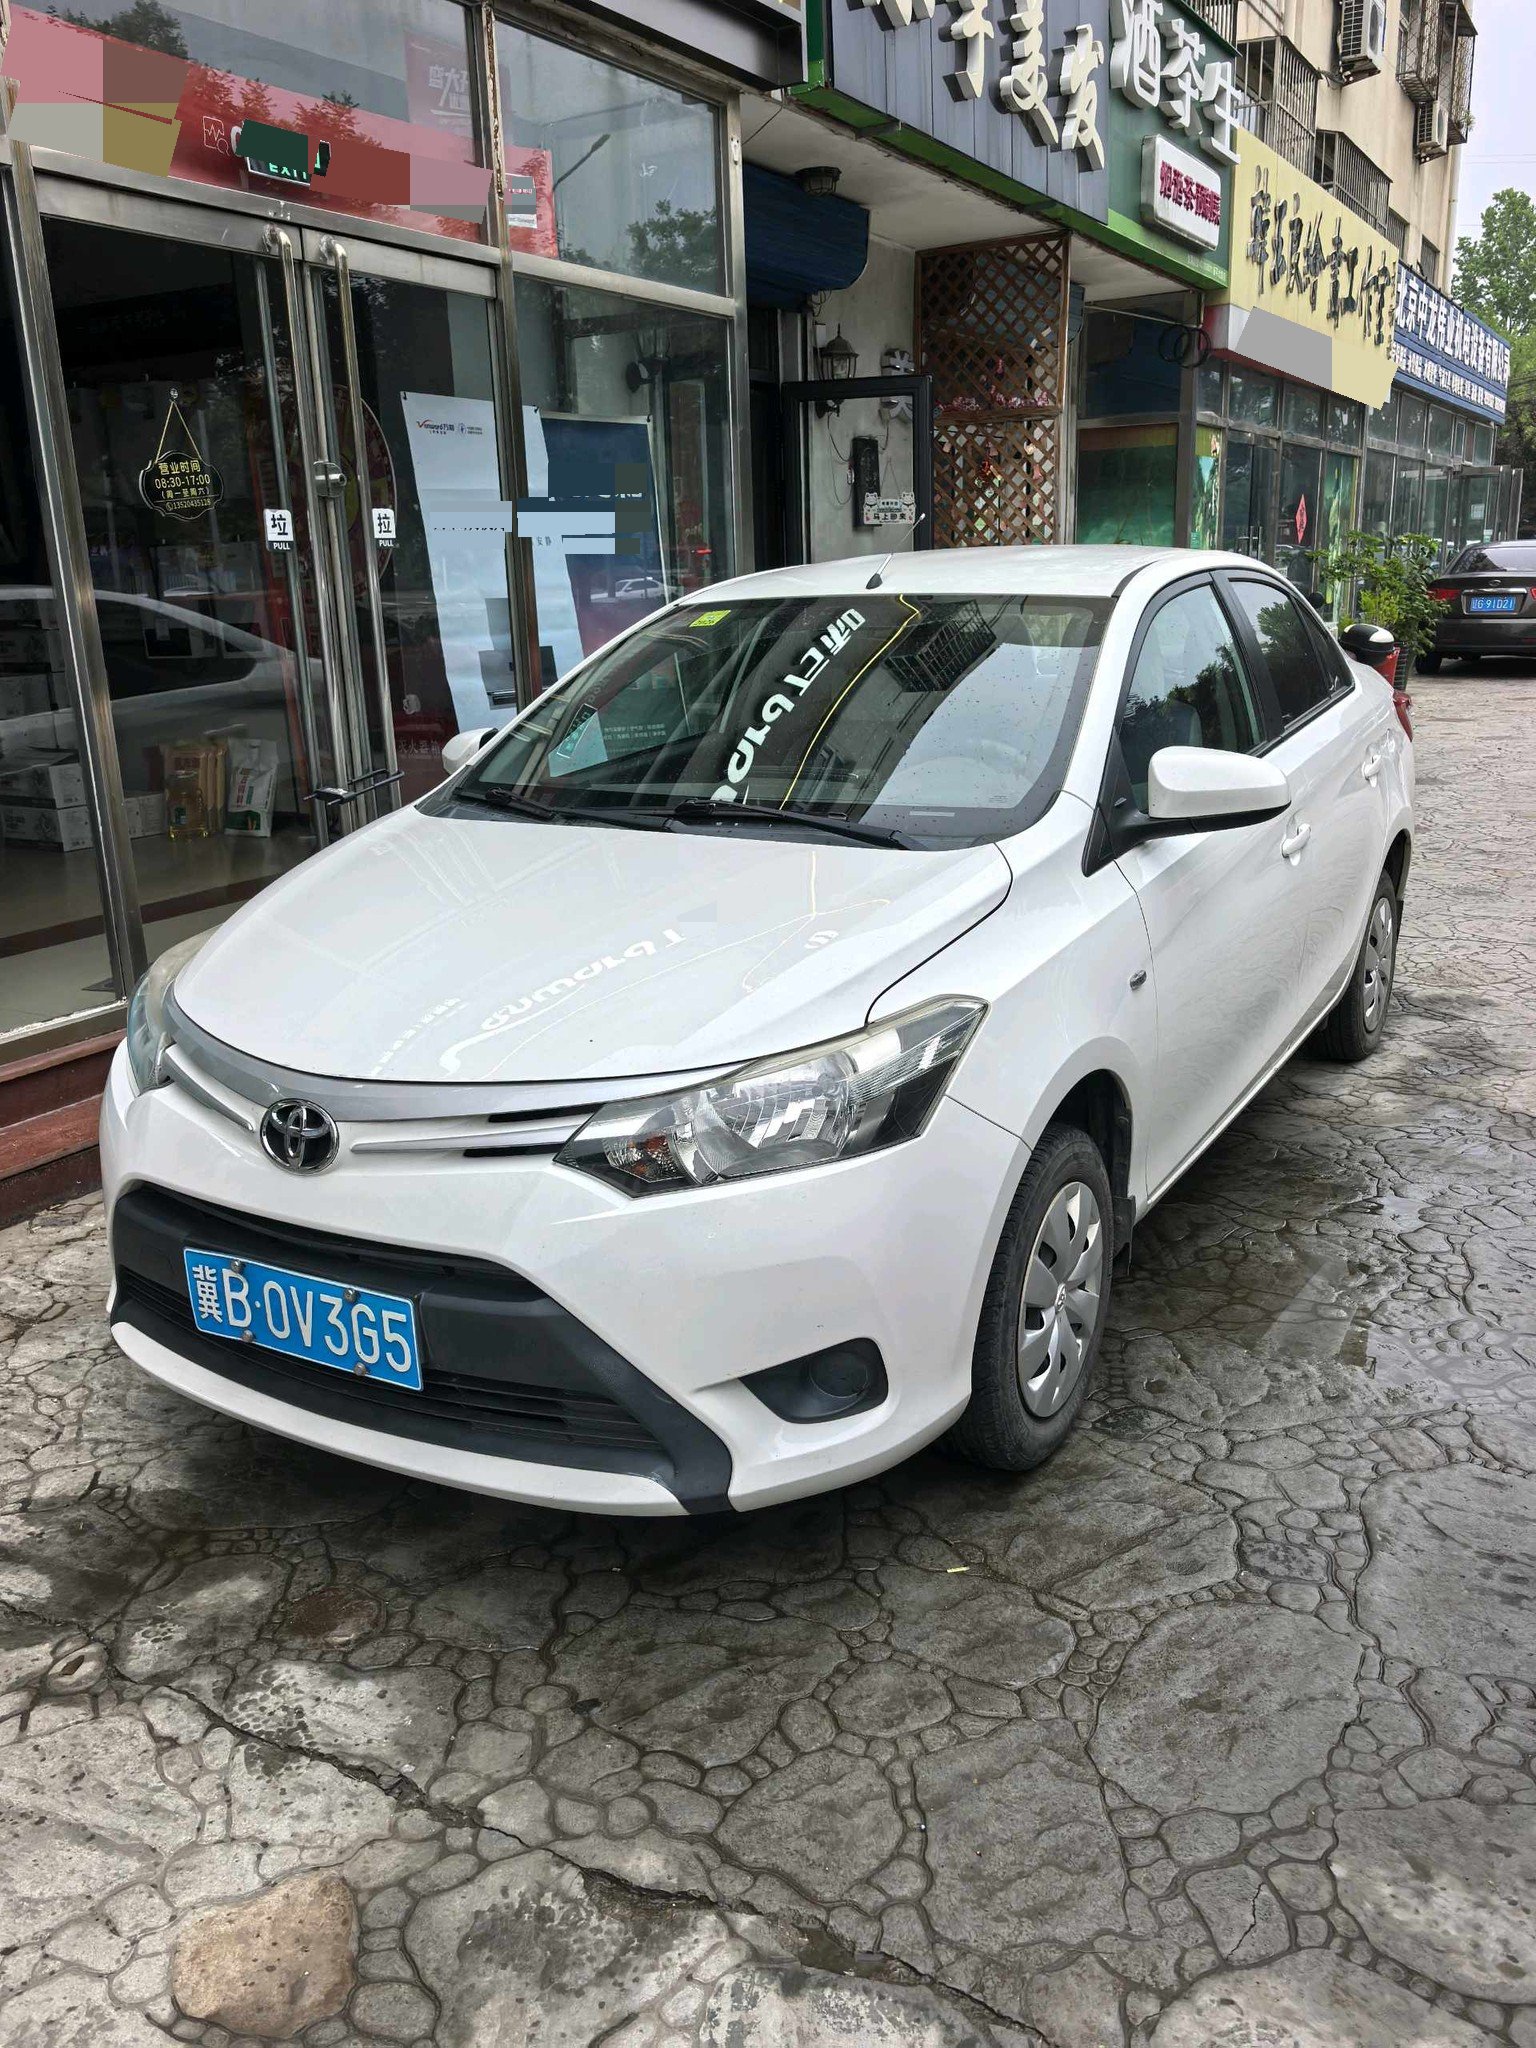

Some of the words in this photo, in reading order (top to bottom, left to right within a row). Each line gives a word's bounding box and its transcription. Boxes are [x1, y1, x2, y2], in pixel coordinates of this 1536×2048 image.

[158, 460, 201, 475] 营业时间
[155, 473, 211, 489] 08:30-17:00
[377, 513, 392, 534] 拉
[273, 542, 291, 550] PULL
[379, 539, 394, 547] PULL
